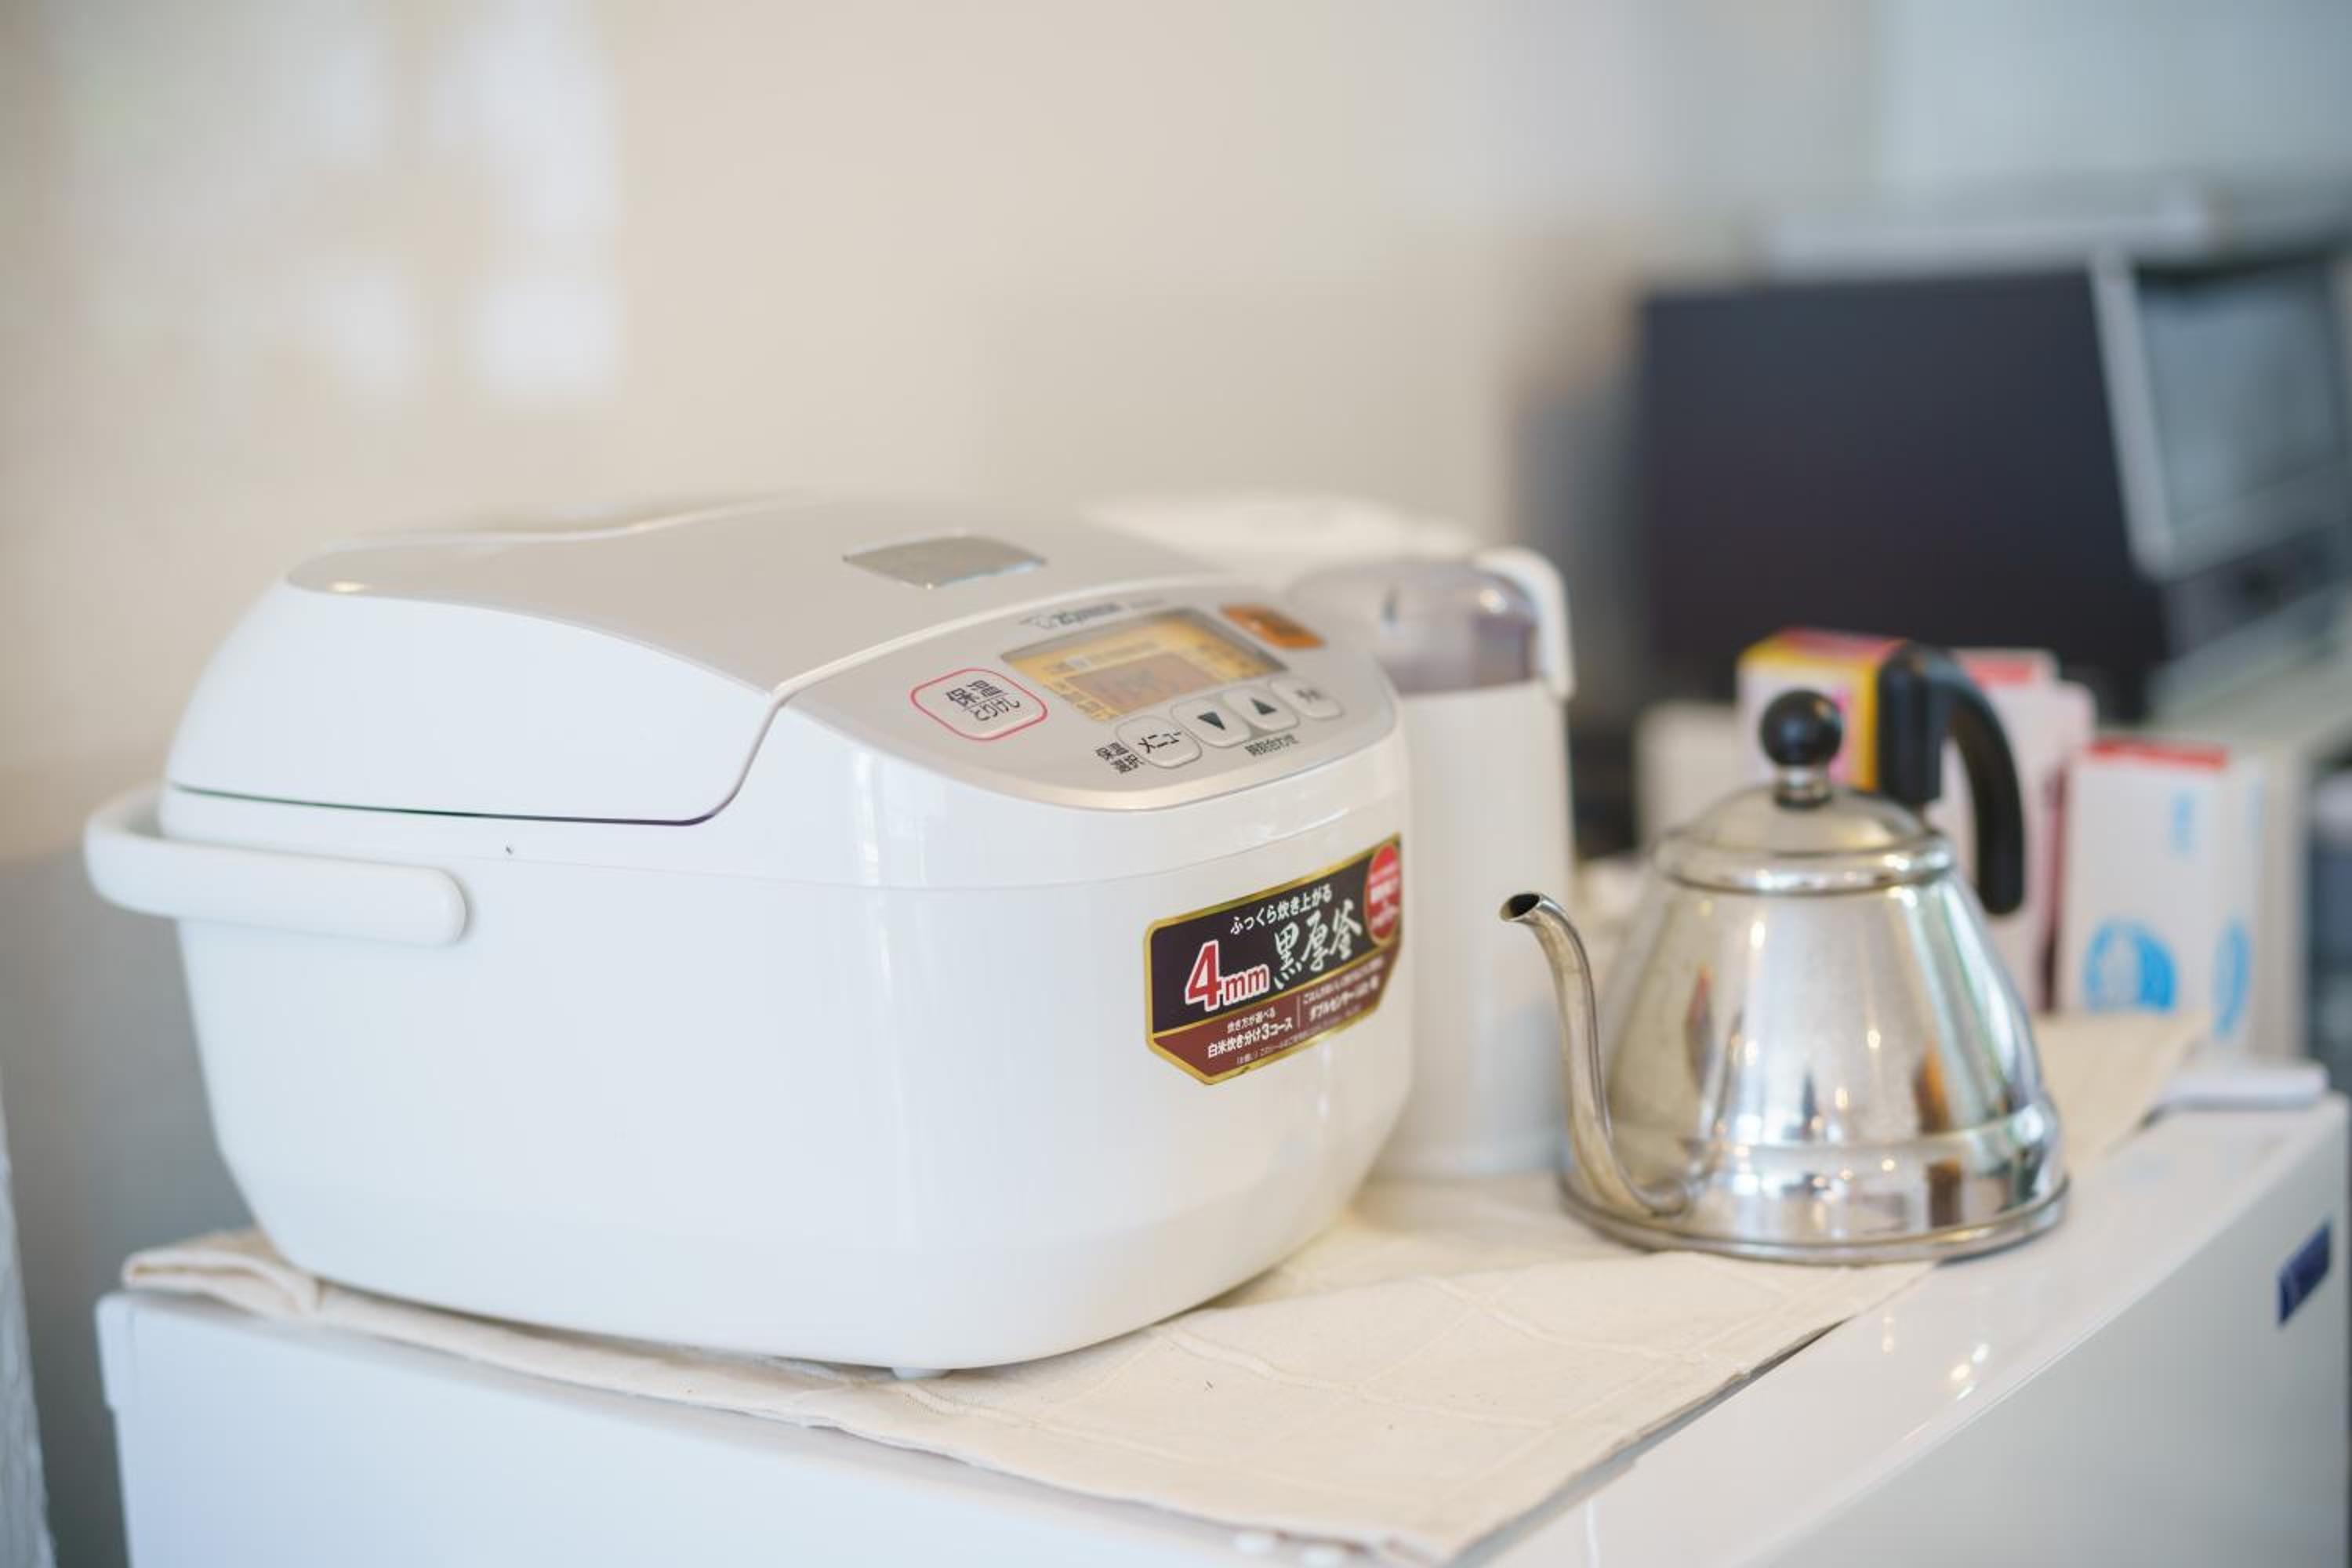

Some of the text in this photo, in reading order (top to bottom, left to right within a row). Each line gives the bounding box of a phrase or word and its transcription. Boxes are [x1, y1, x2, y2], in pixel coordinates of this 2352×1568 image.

[971, 697, 1020, 721] とりけし
[1138, 731, 1181, 753] メニュー
[1230, 883, 1332, 935] ふっくら炊き上がる
[1185, 939, 1270, 1011] 4mm
